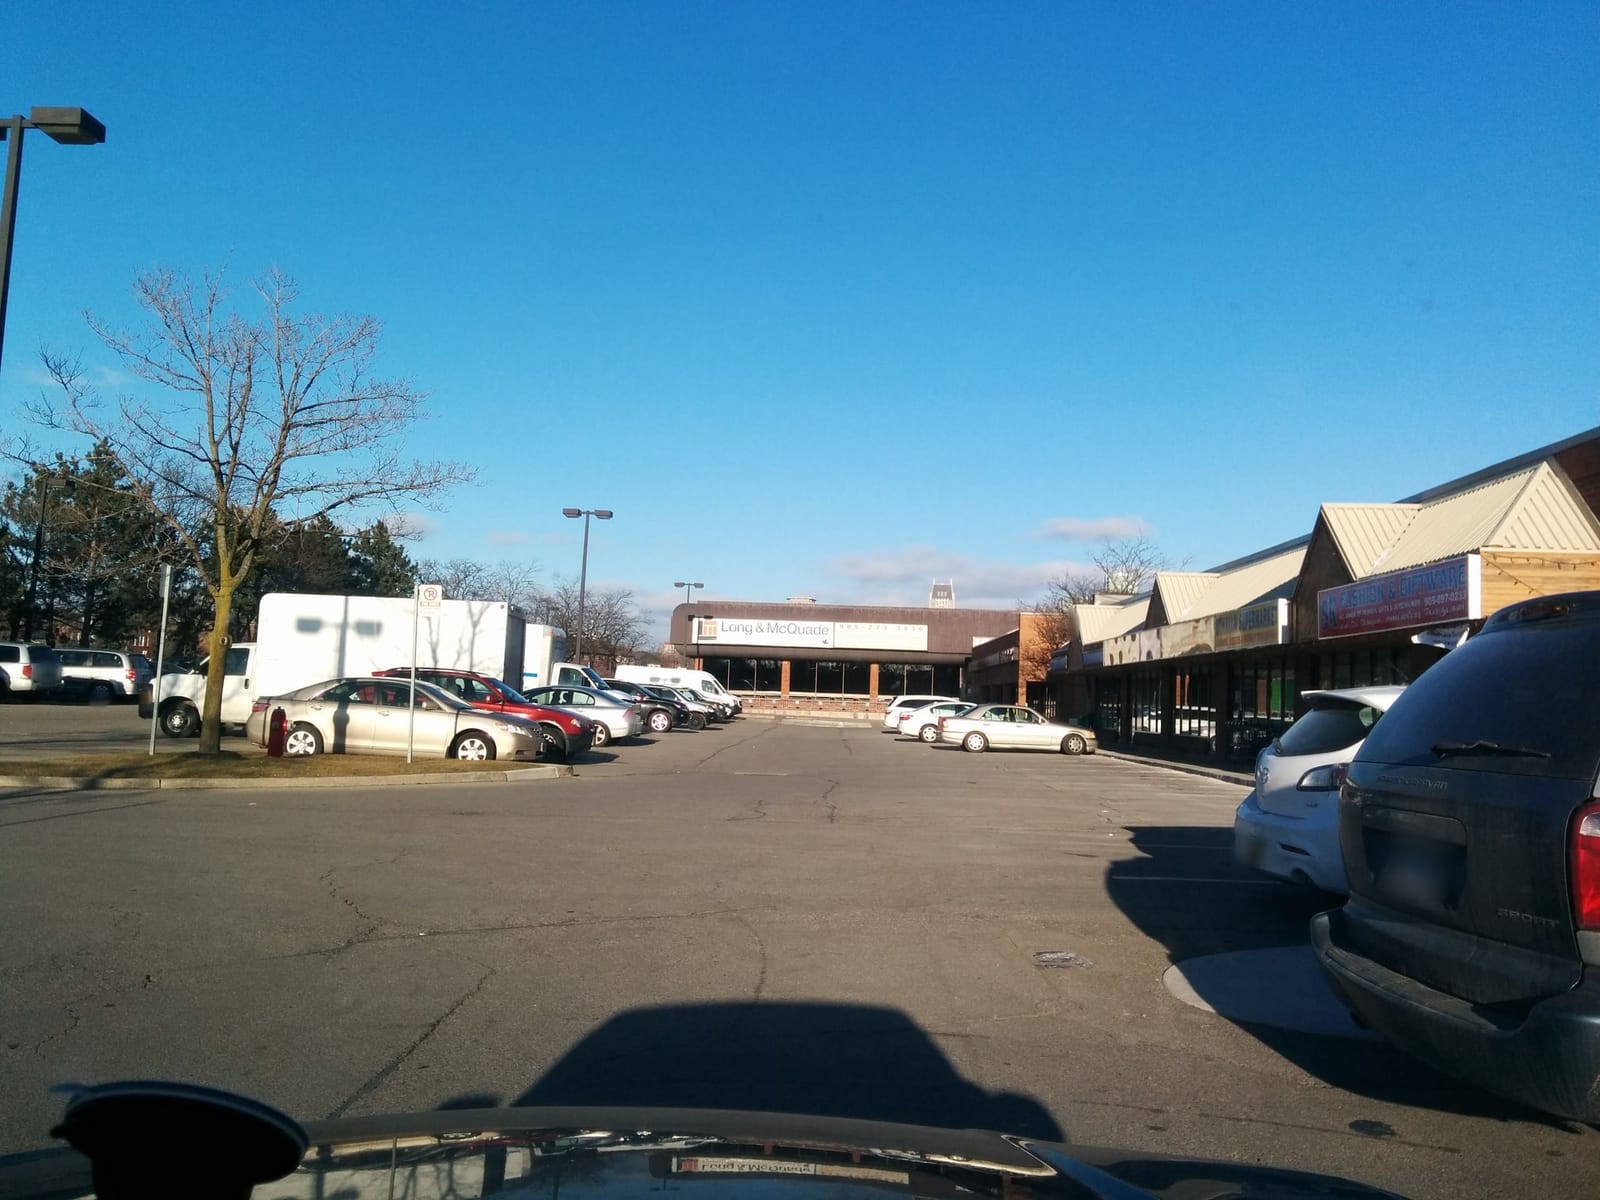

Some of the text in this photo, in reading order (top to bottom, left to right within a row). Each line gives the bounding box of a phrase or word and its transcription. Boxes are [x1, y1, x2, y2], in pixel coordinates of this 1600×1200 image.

[1399, 563, 1466, 597] GIFTWARE
[721, 621, 830, 636] Long & McQuade
